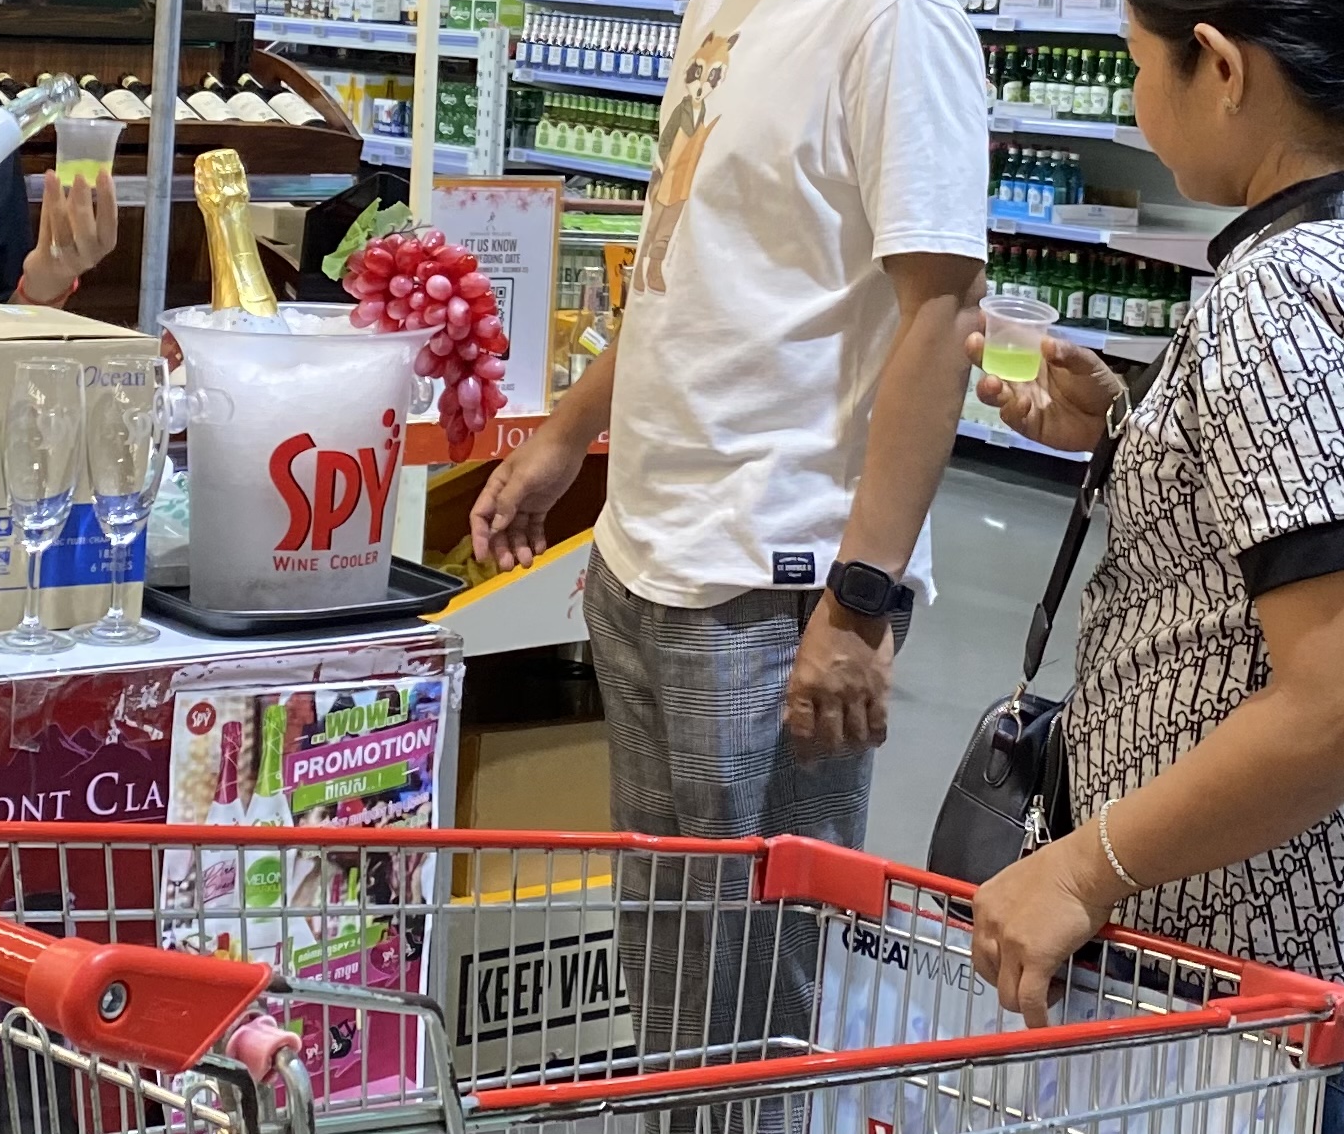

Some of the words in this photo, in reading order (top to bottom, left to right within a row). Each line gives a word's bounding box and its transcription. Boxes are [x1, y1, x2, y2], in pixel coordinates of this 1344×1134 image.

[477, 238, 489, 253] US
[491, 239, 517, 253] KNOW
[76, 365, 146, 387] Ocean
[269, 432, 401, 553] SPY
[273, 554, 319, 572] WINE
[329, 550, 379, 571] COOLER
[191, 708, 212, 728] SPY
[293, 725, 433, 783] PROMOTION
[85, 772, 165, 816] CLA
[478, 958, 552, 1024] KEEP
[560, 947, 627, 1009] WAL
